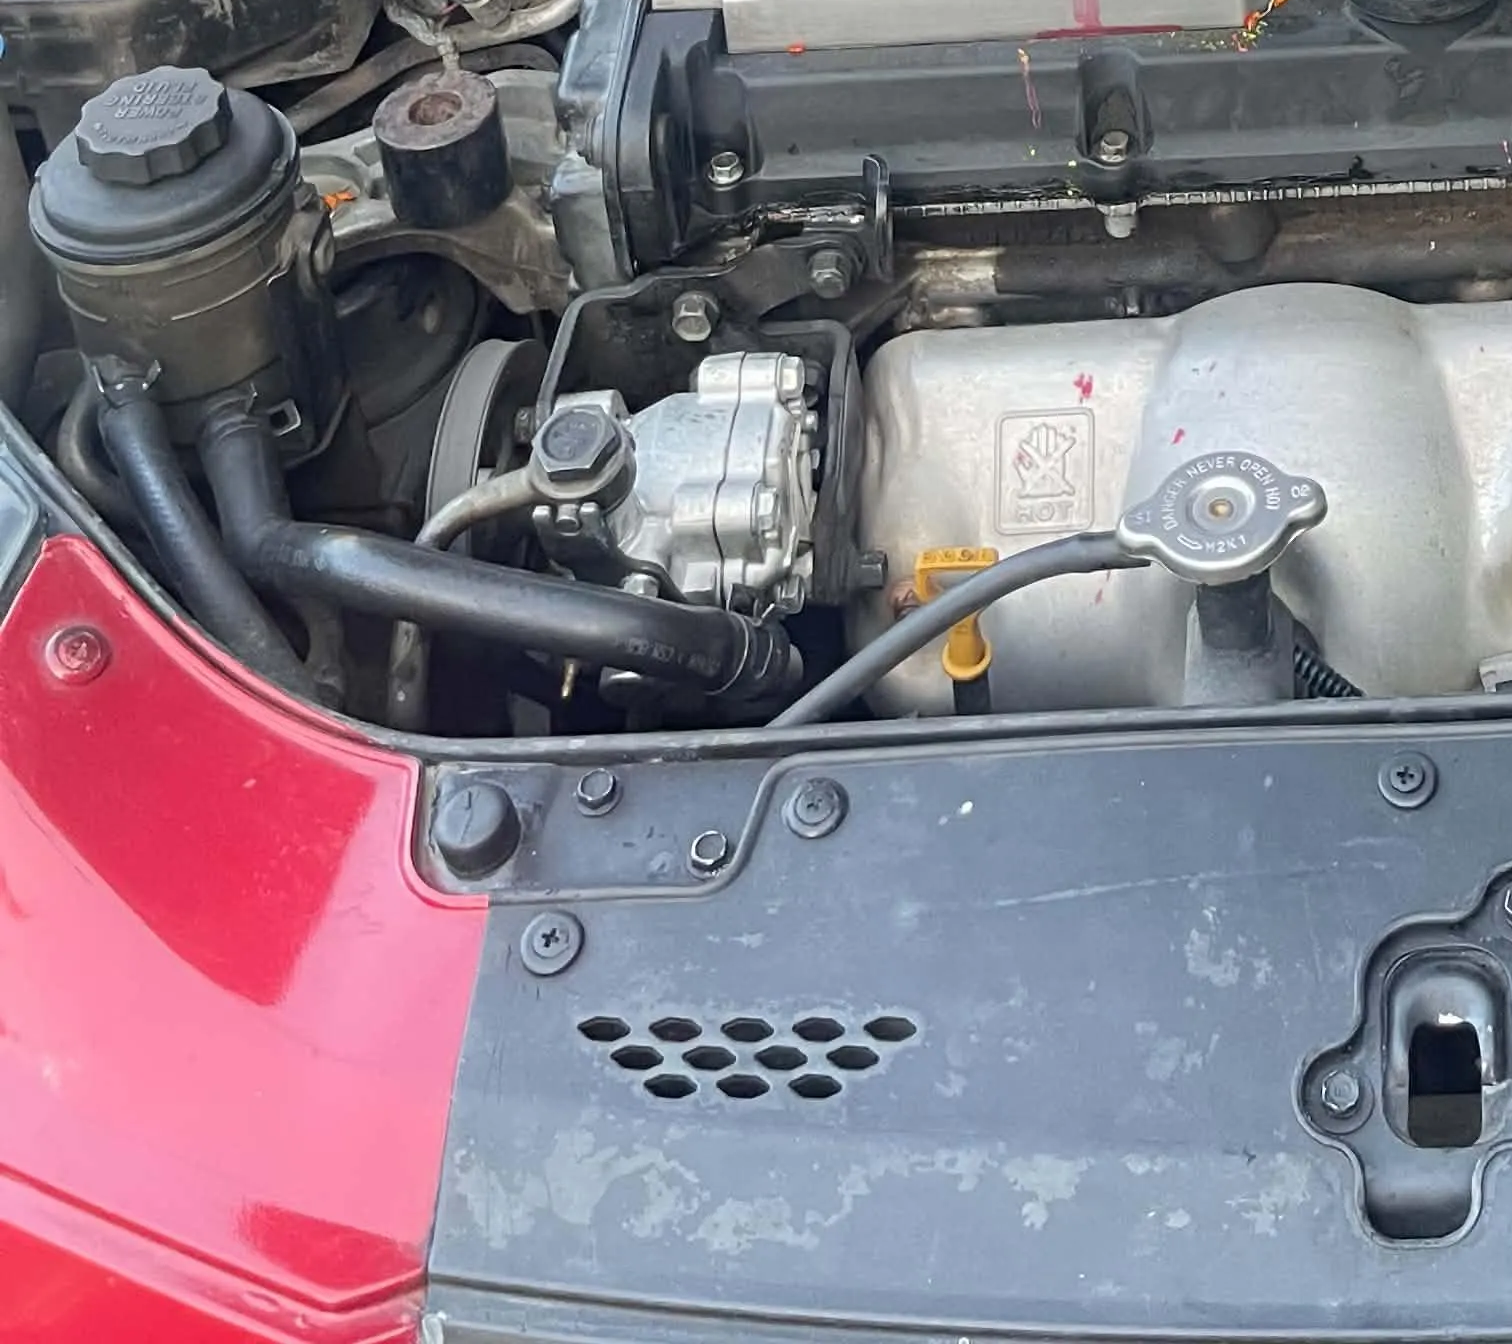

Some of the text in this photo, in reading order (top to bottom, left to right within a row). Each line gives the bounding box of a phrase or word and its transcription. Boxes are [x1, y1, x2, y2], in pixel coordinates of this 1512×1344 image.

[133, 80, 198, 93] FLUID
[103, 92, 209, 107] STEERING
[114, 104, 184, 119] POWER
[1161, 479, 1187, 531] DANGER
[1186, 456, 1235, 479] NEVER
[1239, 459, 1275, 486] OPEN
[1014, 500, 1074, 524] HOT
